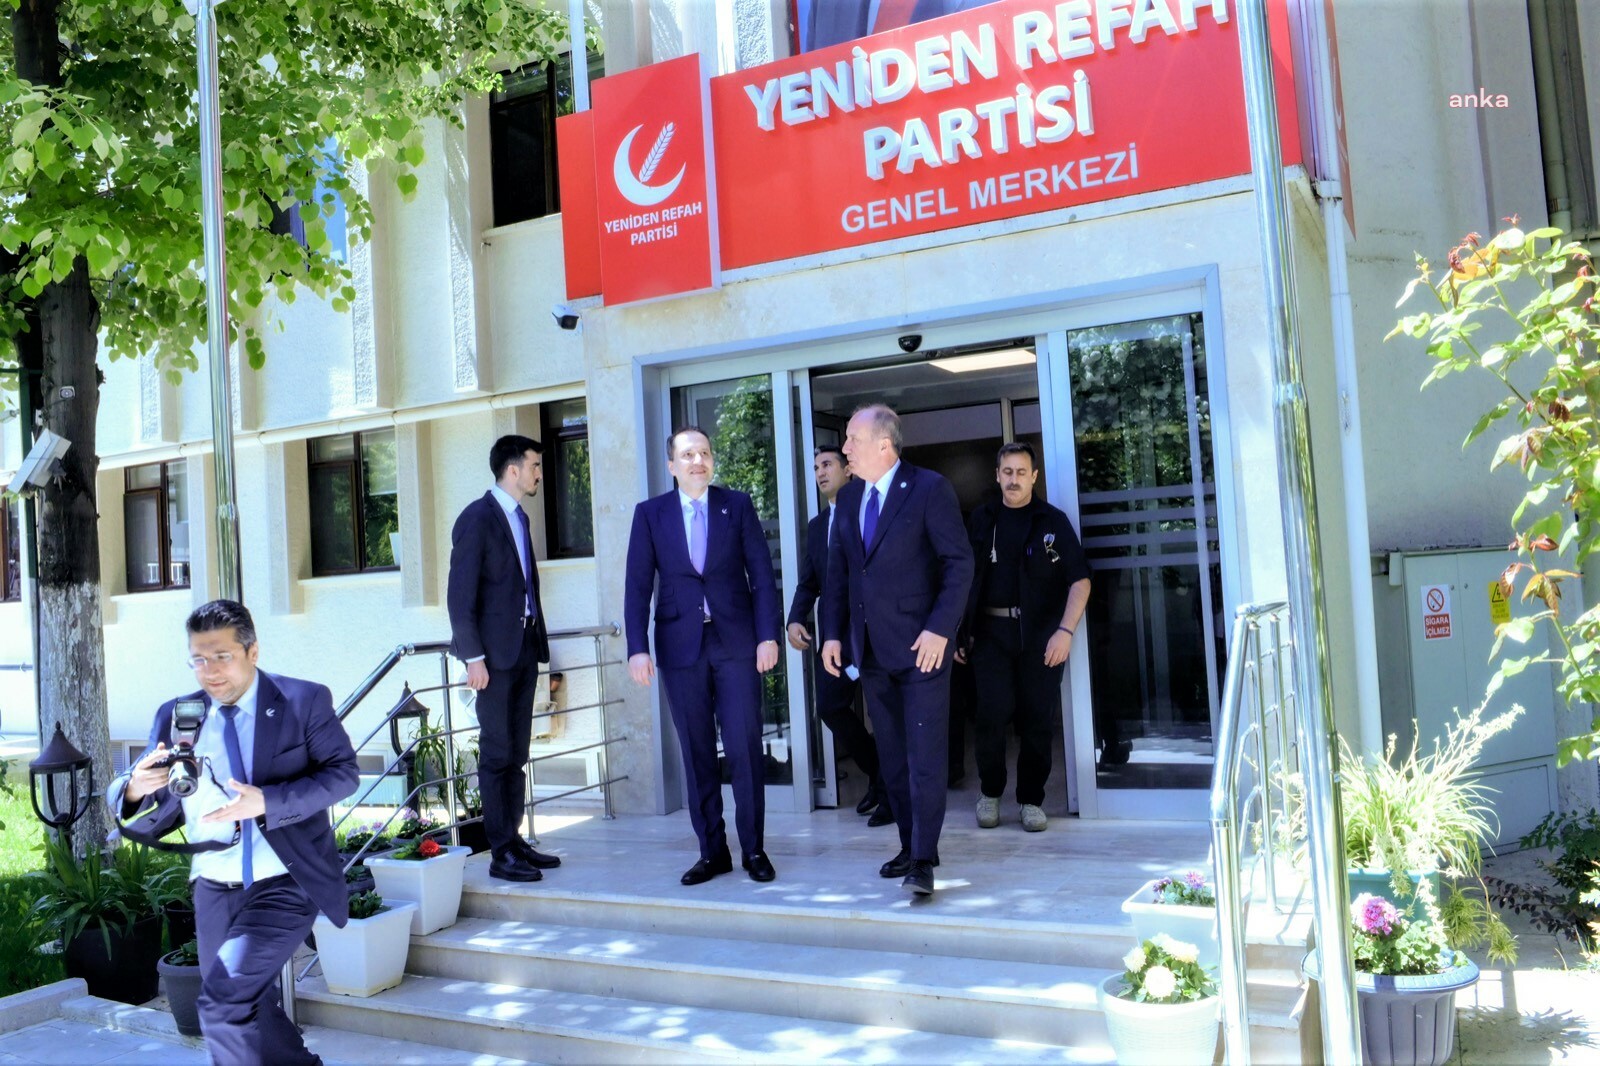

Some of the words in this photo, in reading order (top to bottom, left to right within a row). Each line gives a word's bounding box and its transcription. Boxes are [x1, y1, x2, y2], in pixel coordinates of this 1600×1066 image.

[743, 22, 999, 132] YENİDEN
[863, 69, 1095, 181] PARTİSİ
[604, 211, 659, 234] YENİDEN
[661, 201, 702, 222] REFAH
[840, 187, 959, 233] GENEL
[968, 142, 1139, 209] MERKEZİ
[630, 222, 678, 246] PARTİSİ
[1425, 615, 1449, 625] SİGARA
